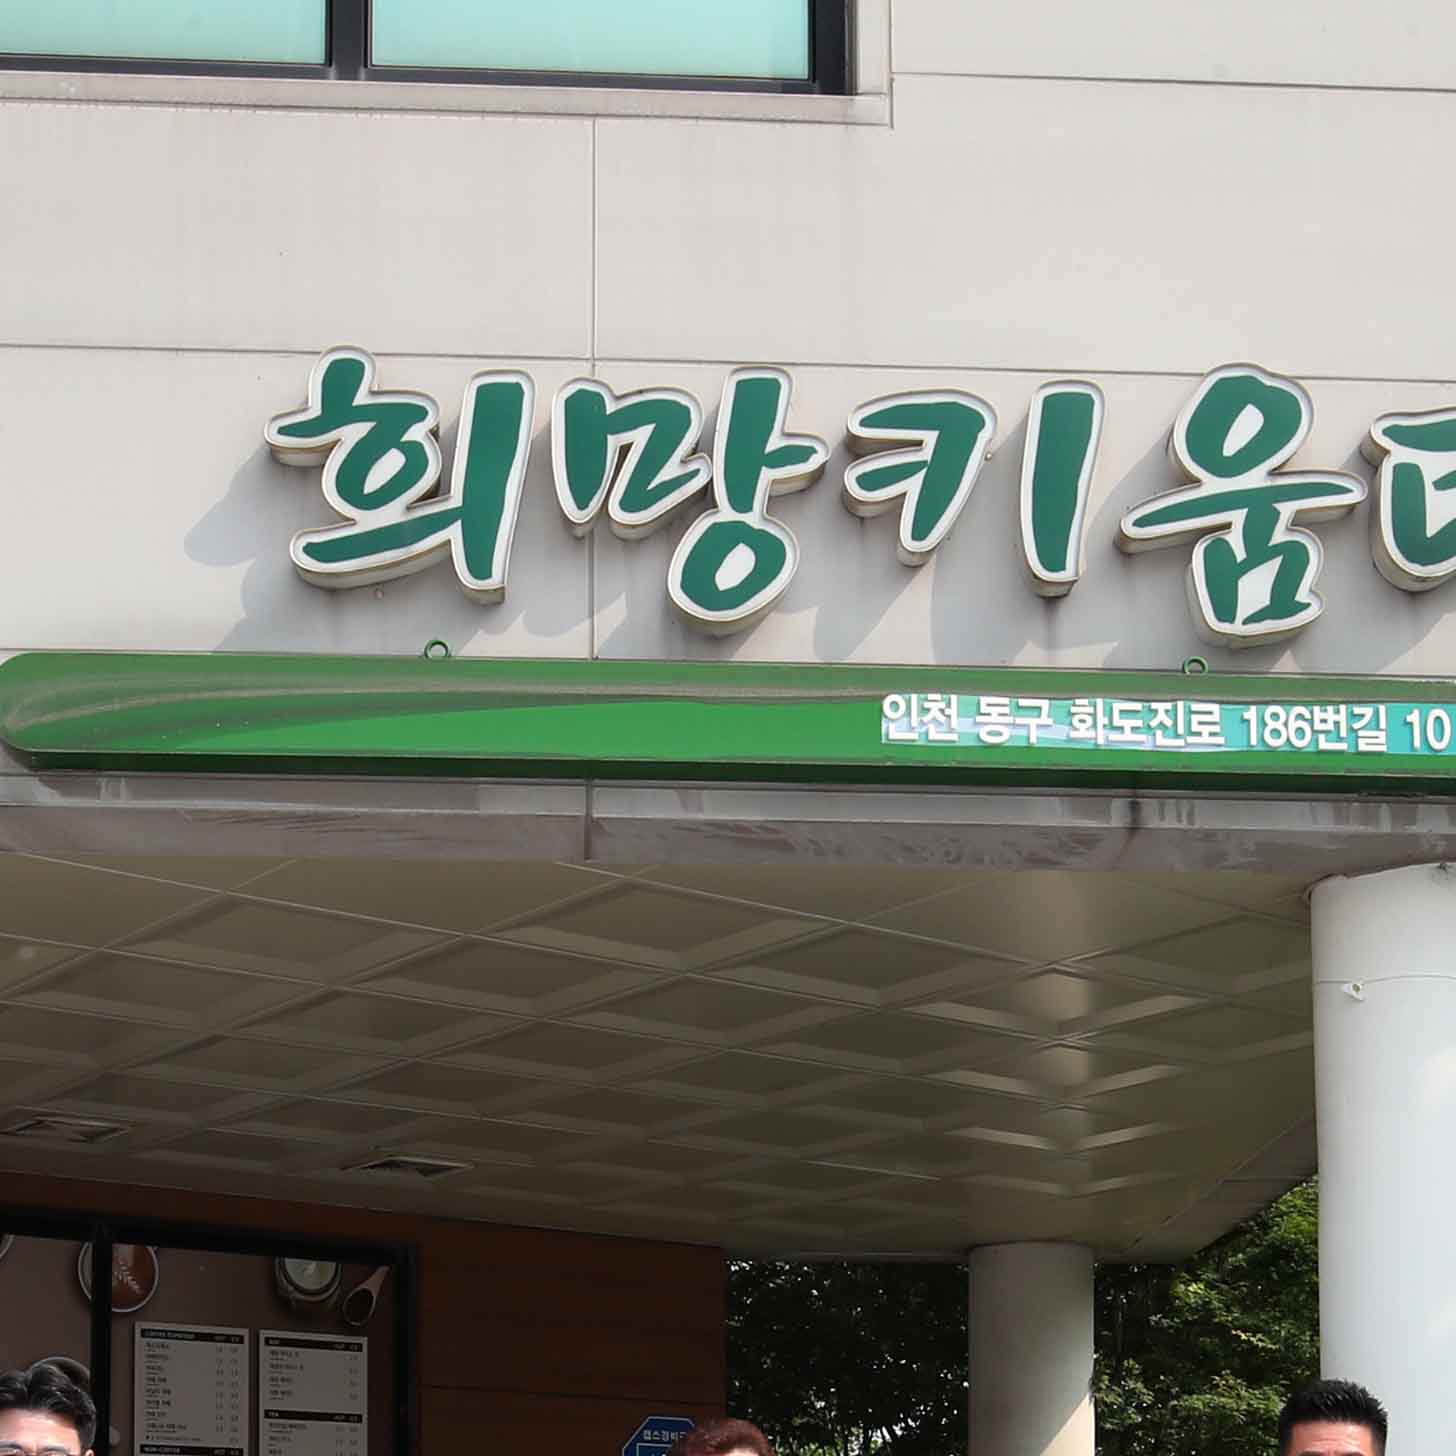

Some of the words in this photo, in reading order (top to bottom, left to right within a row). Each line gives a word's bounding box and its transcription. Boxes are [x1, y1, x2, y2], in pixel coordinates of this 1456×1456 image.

[881, 693, 959, 743] 인천
[975, 696, 1054, 745] 동구
[1069, 698, 1226, 747] 화도진로
[1243, 702, 1389, 753] 186번길
[1405, 706, 1452, 749] 10
